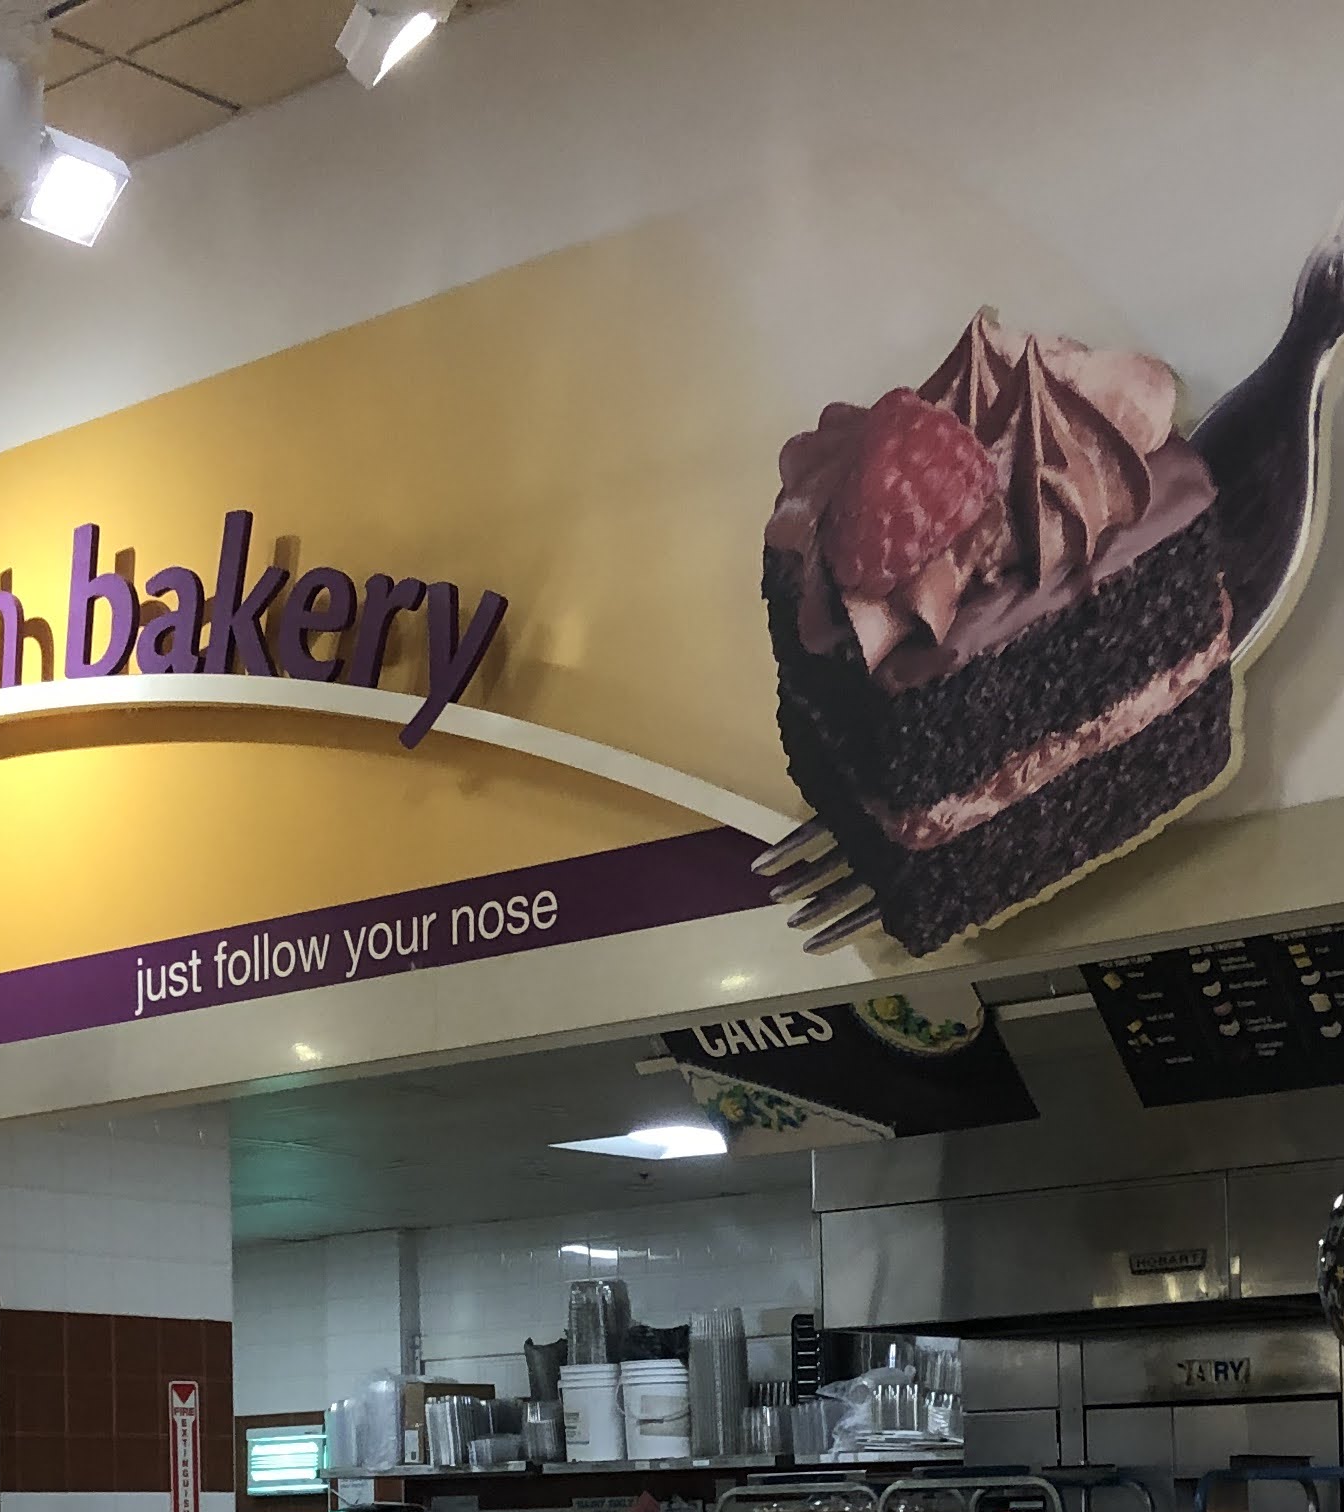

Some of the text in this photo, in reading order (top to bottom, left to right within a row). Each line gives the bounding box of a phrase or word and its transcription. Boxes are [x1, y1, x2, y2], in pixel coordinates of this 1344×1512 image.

[65, 510, 508, 750] bakery
[135, 888, 558, 1016] just follow your nose
[691, 1008, 834, 1058] CAKES
[173, 1407, 195, 1416] FIRE
